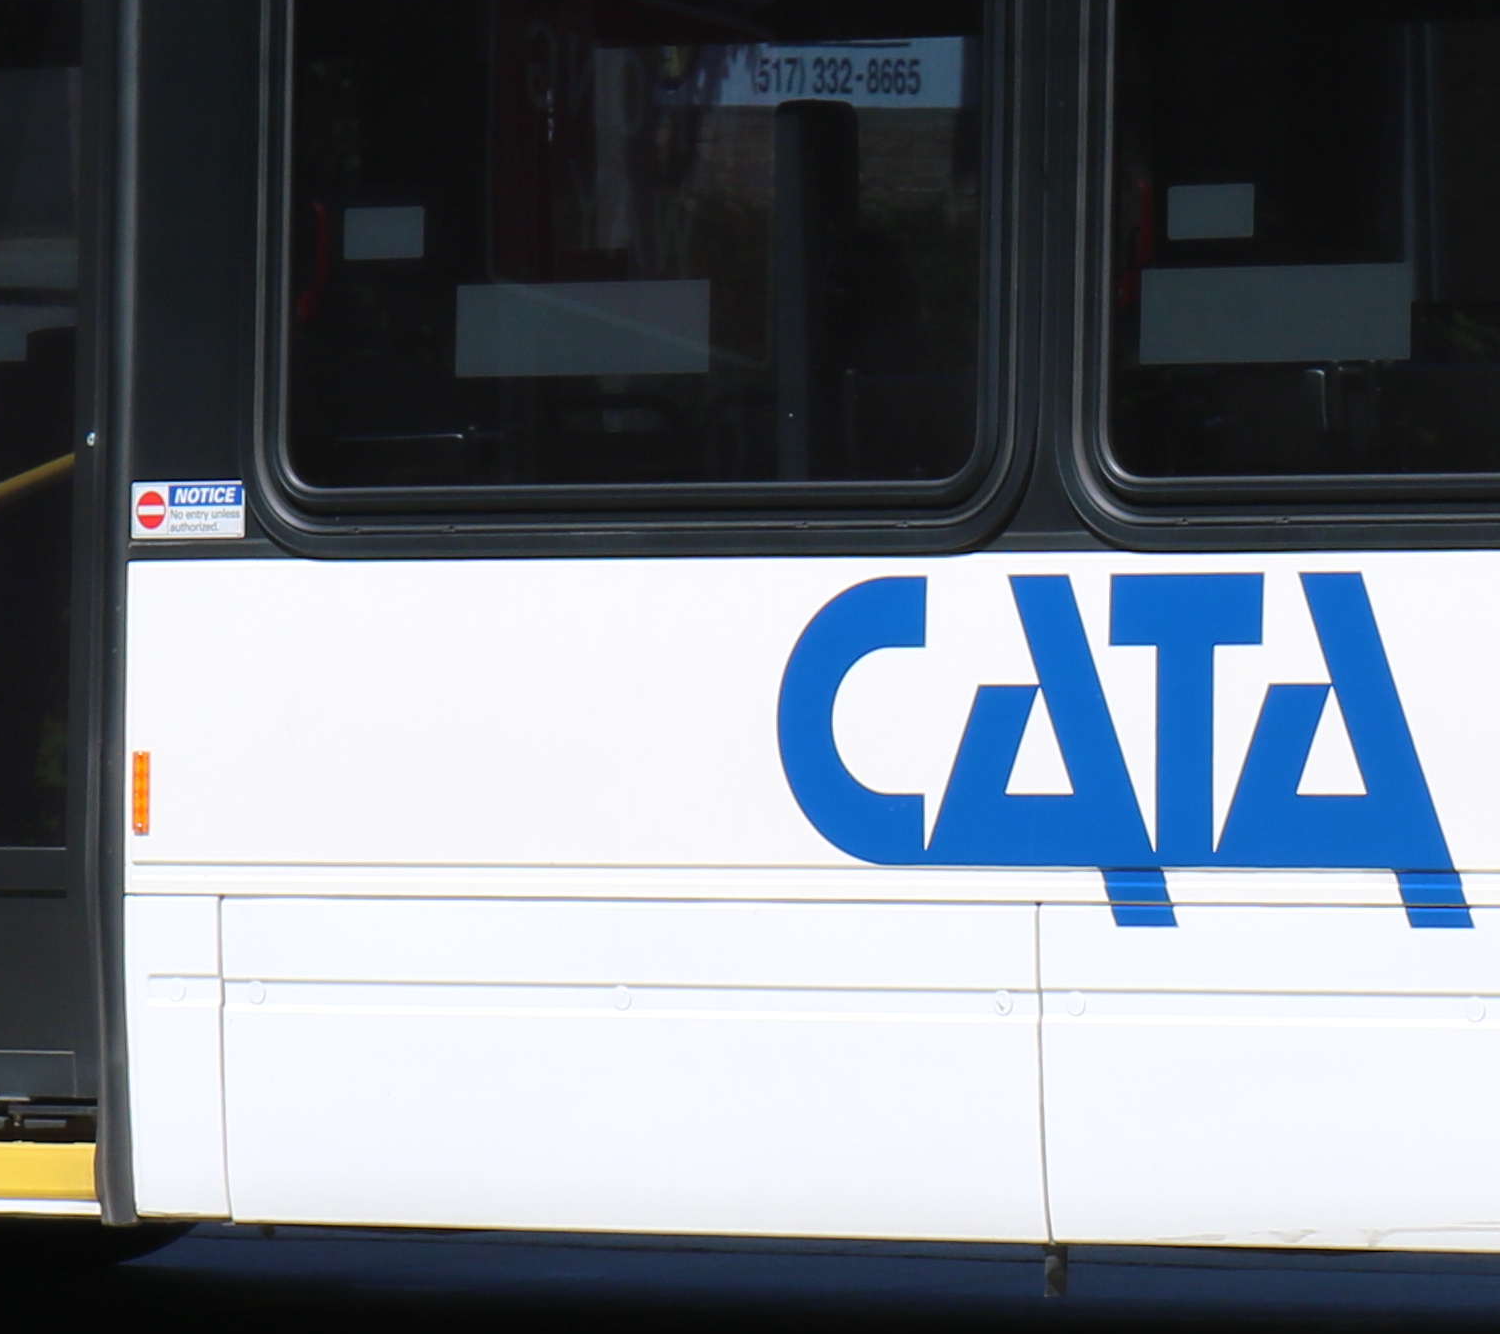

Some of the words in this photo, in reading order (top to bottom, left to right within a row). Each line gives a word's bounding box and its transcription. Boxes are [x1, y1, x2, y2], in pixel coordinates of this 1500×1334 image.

[751, 58, 807, 96] (517)
[812, 58, 922, 96] 332-8665
[174, 486, 237, 504] NOTICE
[169, 509, 183, 519] No
[185, 509, 209, 520] entry
[210, 508, 241, 519] unless
[169, 521, 220, 533] authorized.
[776, 570, 1476, 929] CATA
